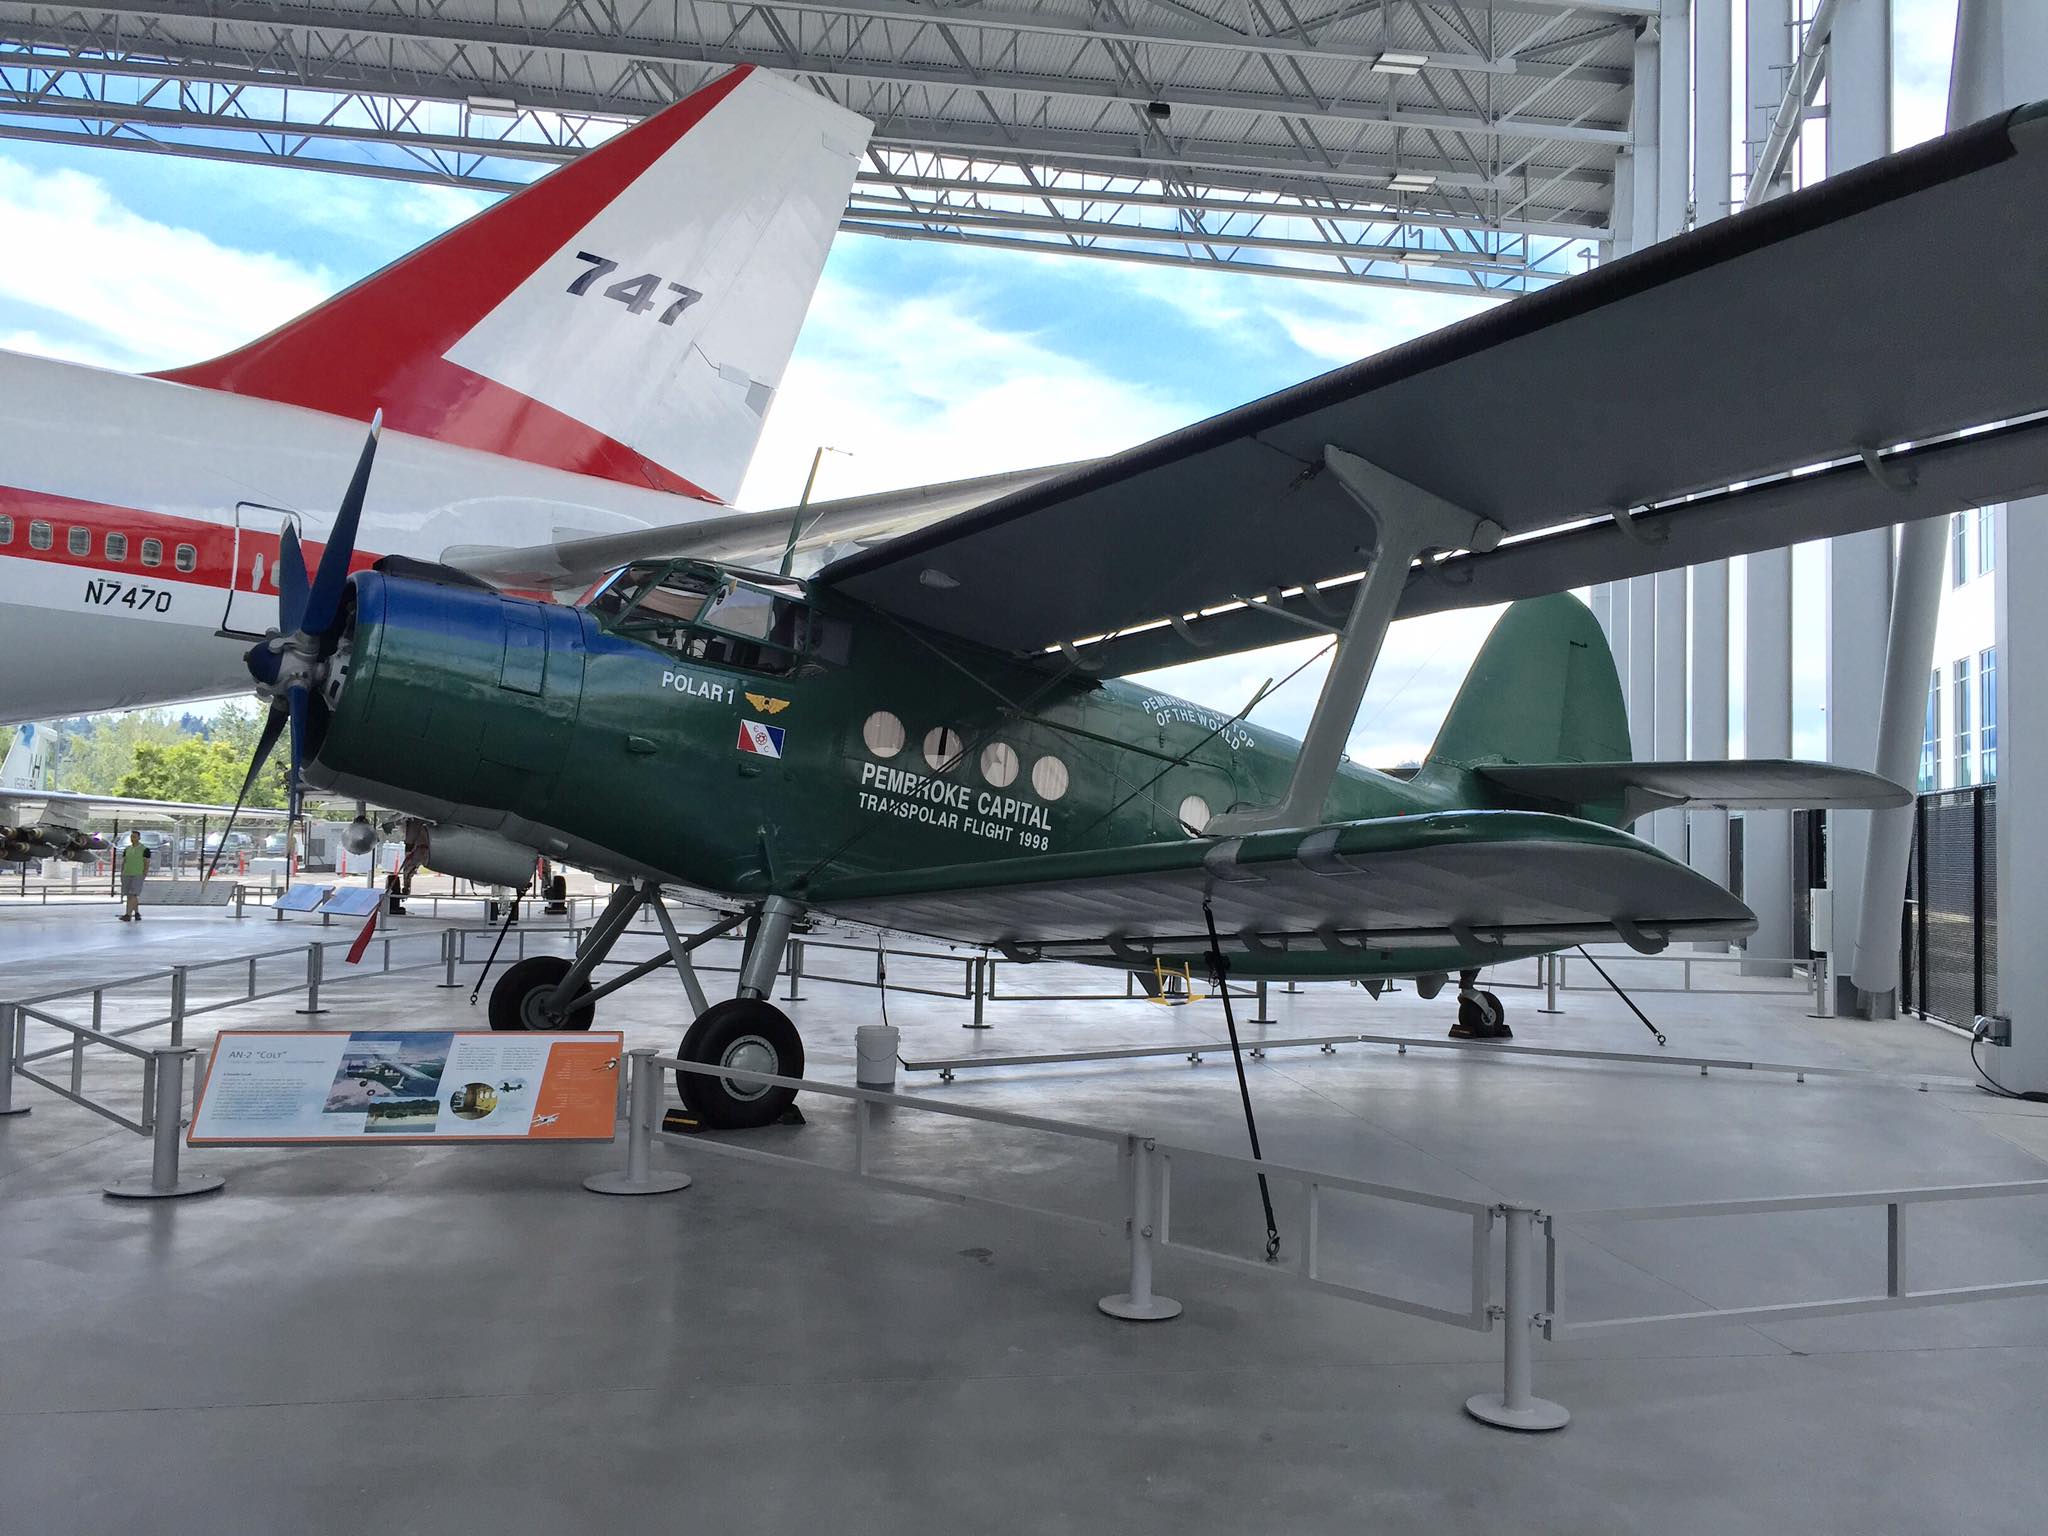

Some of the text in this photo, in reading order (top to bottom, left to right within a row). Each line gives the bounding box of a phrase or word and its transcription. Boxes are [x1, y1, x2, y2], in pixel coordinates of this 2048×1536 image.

[567, 251, 703, 326] 747
[85, 580, 172, 613] N7470
[661, 671, 735, 705] POLAR 1
[1156, 708, 1240, 750] OF THE WORLD
[1231, 720, 1255, 748] TOP
[861, 762, 1052, 831] PEMBROKE CAPITAL
[859, 792, 1049, 851] TRANSPOLAR FLIGHT 1998
[228, 1050, 253, 1059] AN-2
